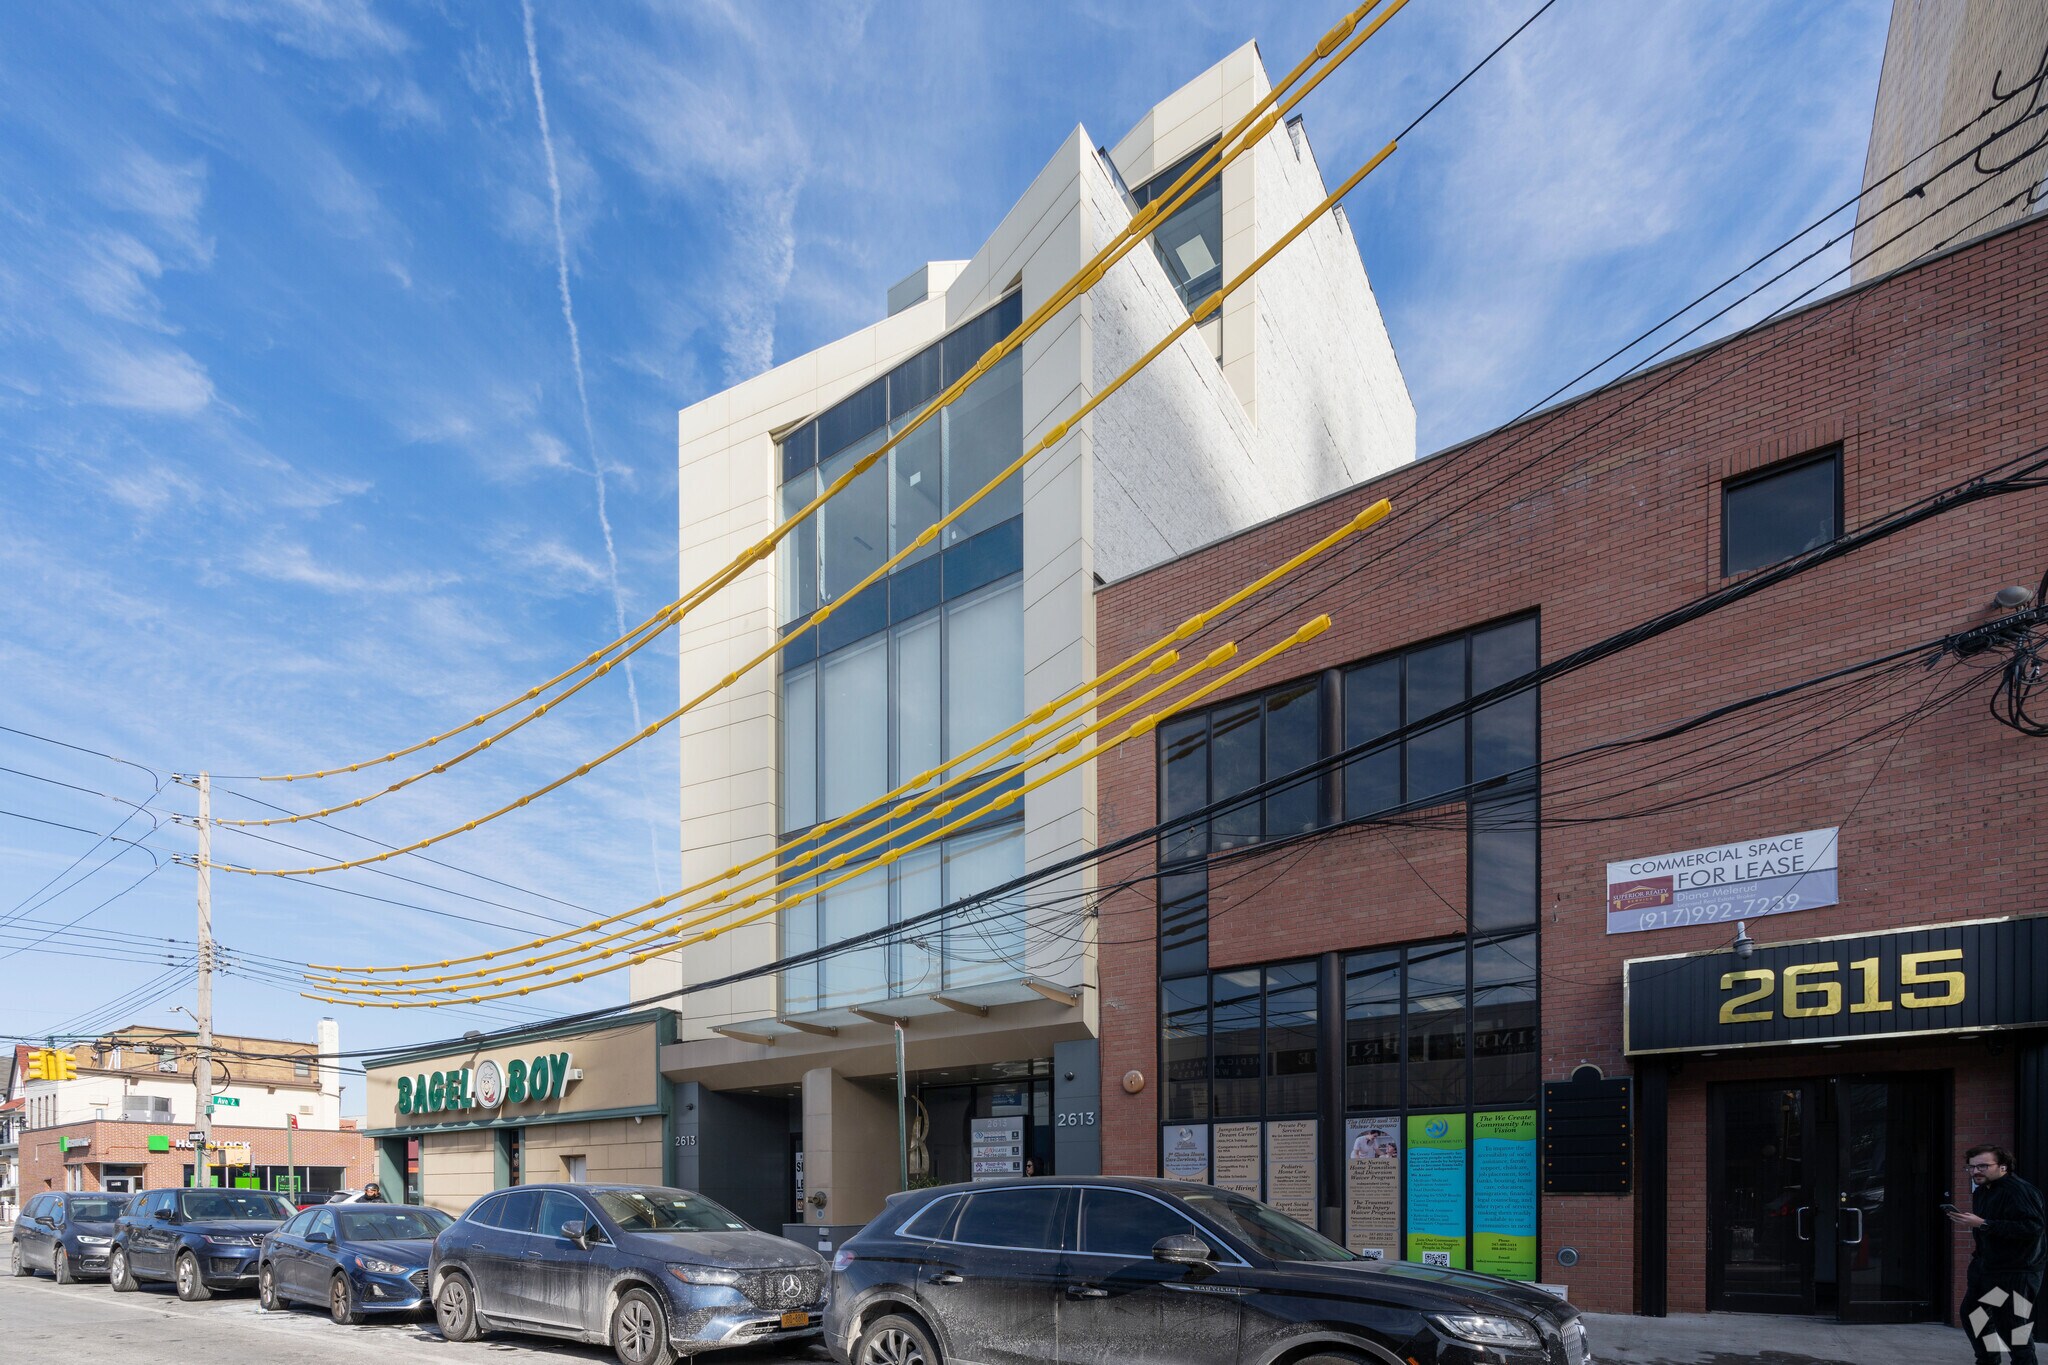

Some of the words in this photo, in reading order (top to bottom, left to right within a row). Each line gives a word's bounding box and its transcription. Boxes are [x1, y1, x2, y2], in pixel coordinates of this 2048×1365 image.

[1630, 848, 1742, 875] COMMERCIAL
[1748, 837, 1804, 857] SPACE
[1678, 867, 1725, 889] FOR
[1735, 855, 1804, 881] LEASE
[1613, 891, 1645, 901] SUPERIOR
[1645, 887, 1668, 896] REALTY
[1677, 892, 1709, 902] Diana
[1713, 883, 1758, 896] Melerud
[1639, 893, 1800, 931] (917)992-7239
[1719, 948, 1966, 1025] 2615
[397, 1067, 477, 1115] BAGEL
[508, 1052, 572, 1103] BOY
[987, 1119, 1007, 1128] 2613
[1057, 1111, 1095, 1126] 2613
[675, 1135, 696, 1146] 2613
[1193, 1285, 1237, 1293] NAUTILUS
